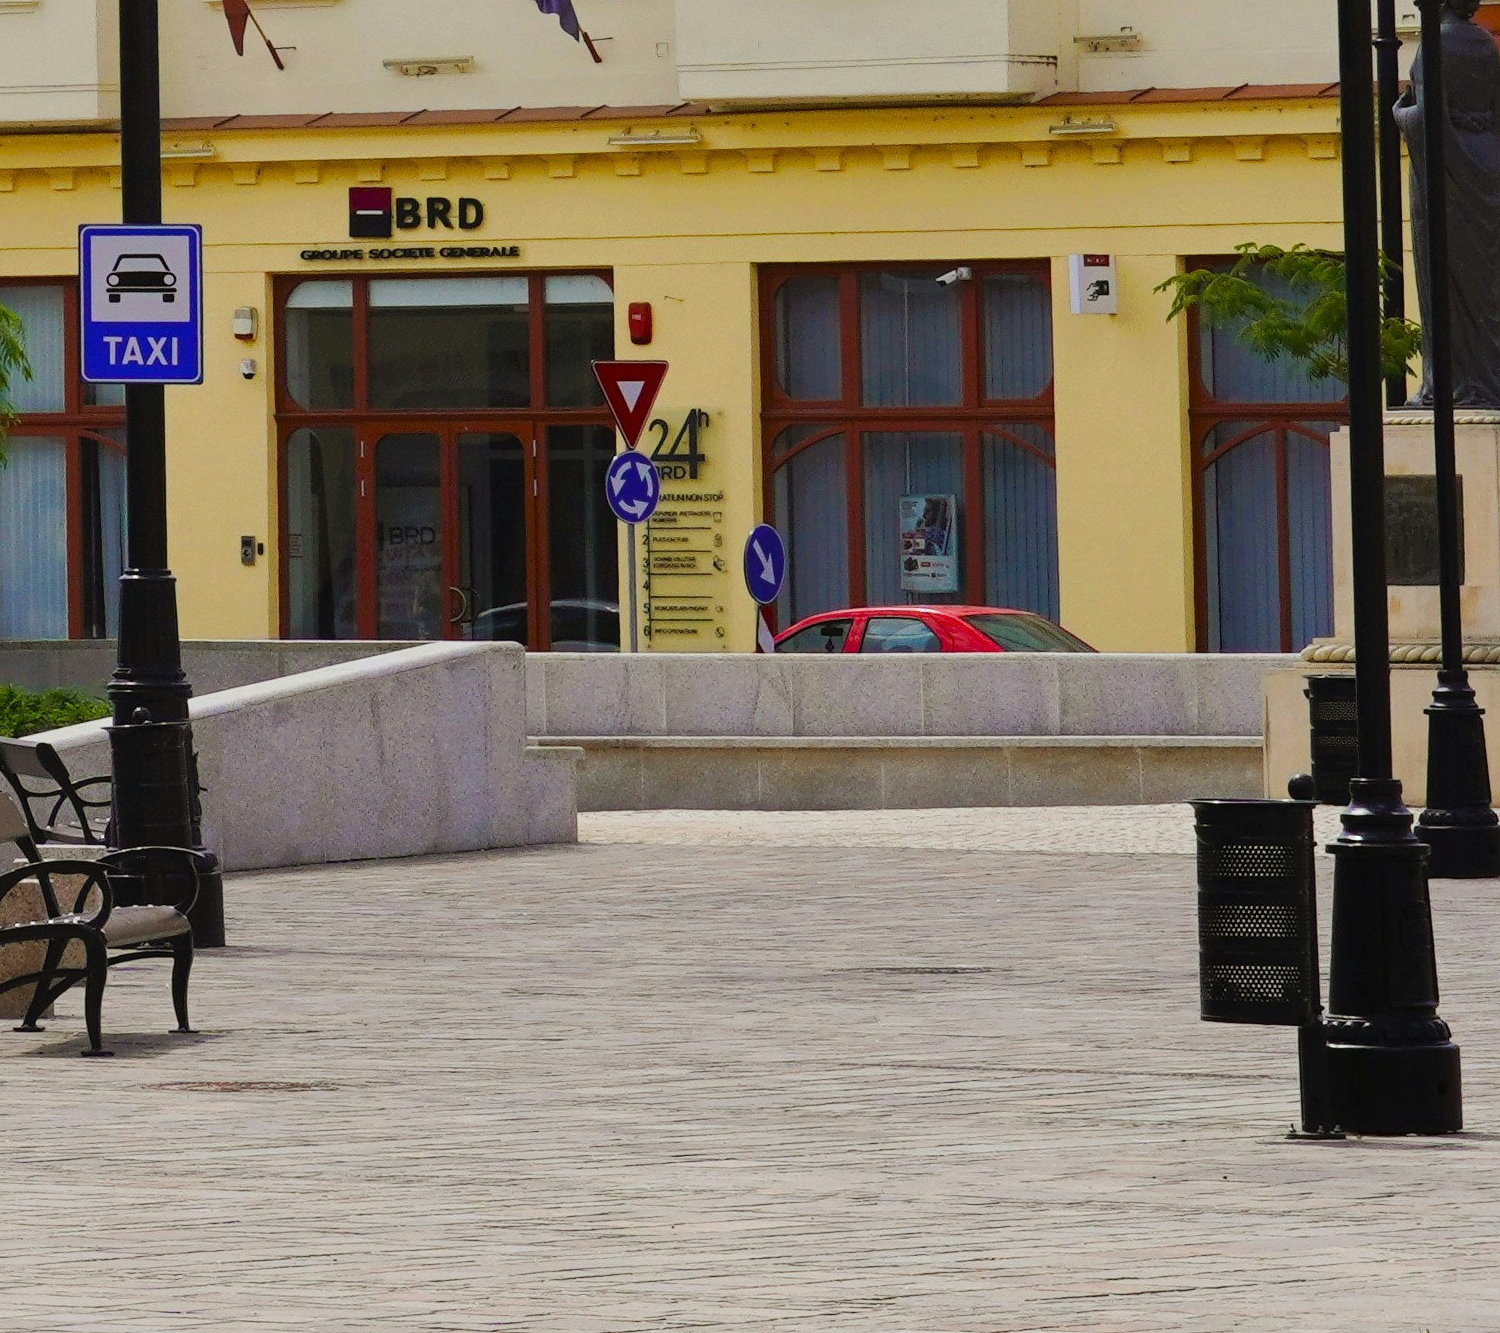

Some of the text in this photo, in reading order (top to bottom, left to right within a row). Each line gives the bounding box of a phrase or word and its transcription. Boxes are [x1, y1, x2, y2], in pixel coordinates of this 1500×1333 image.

[395, 196, 485, 230] BRD
[300, 245, 521, 261] GROUPE SOCIETE GENERALE
[102, 336, 179, 366] TAXI
[703, 493, 724, 502] STOP
